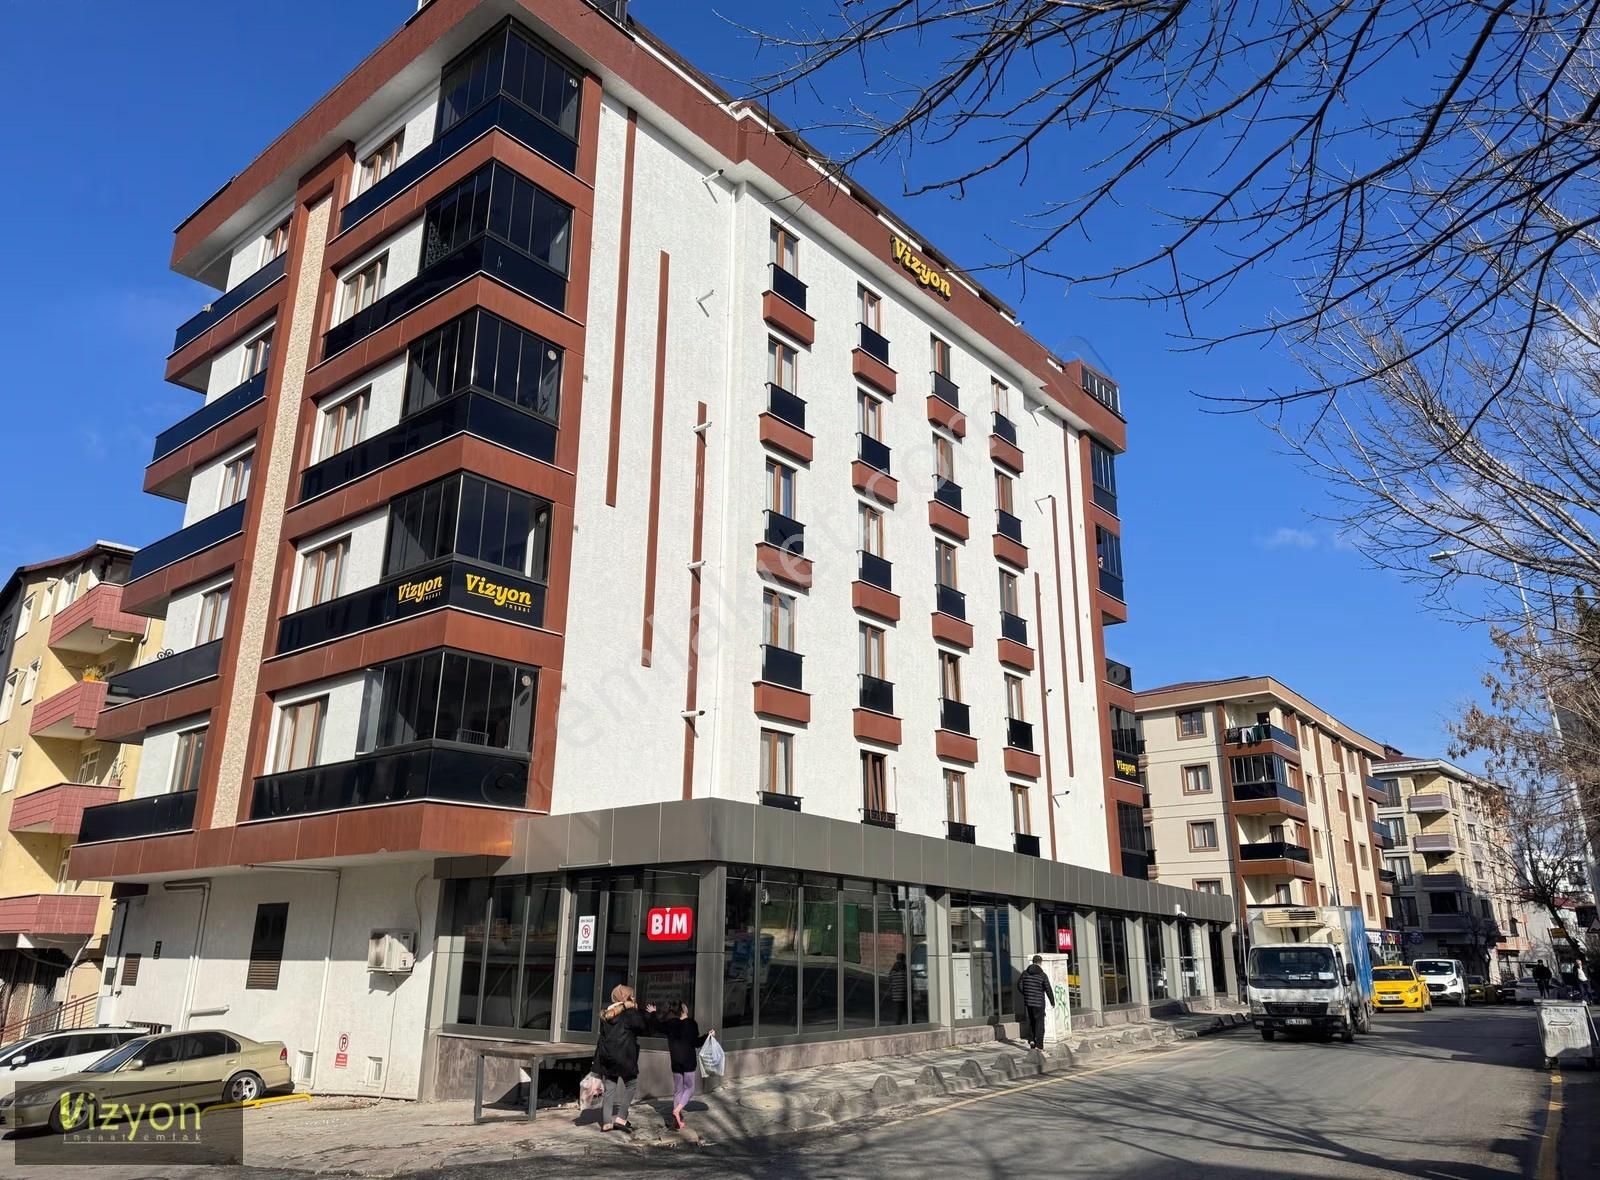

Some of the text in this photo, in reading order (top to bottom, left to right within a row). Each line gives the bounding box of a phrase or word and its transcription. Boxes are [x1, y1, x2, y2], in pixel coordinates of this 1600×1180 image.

[891, 236, 952, 298] Vizyon
[398, 575, 443, 603] Vizyon
[465, 573, 532, 607] Vizyon
